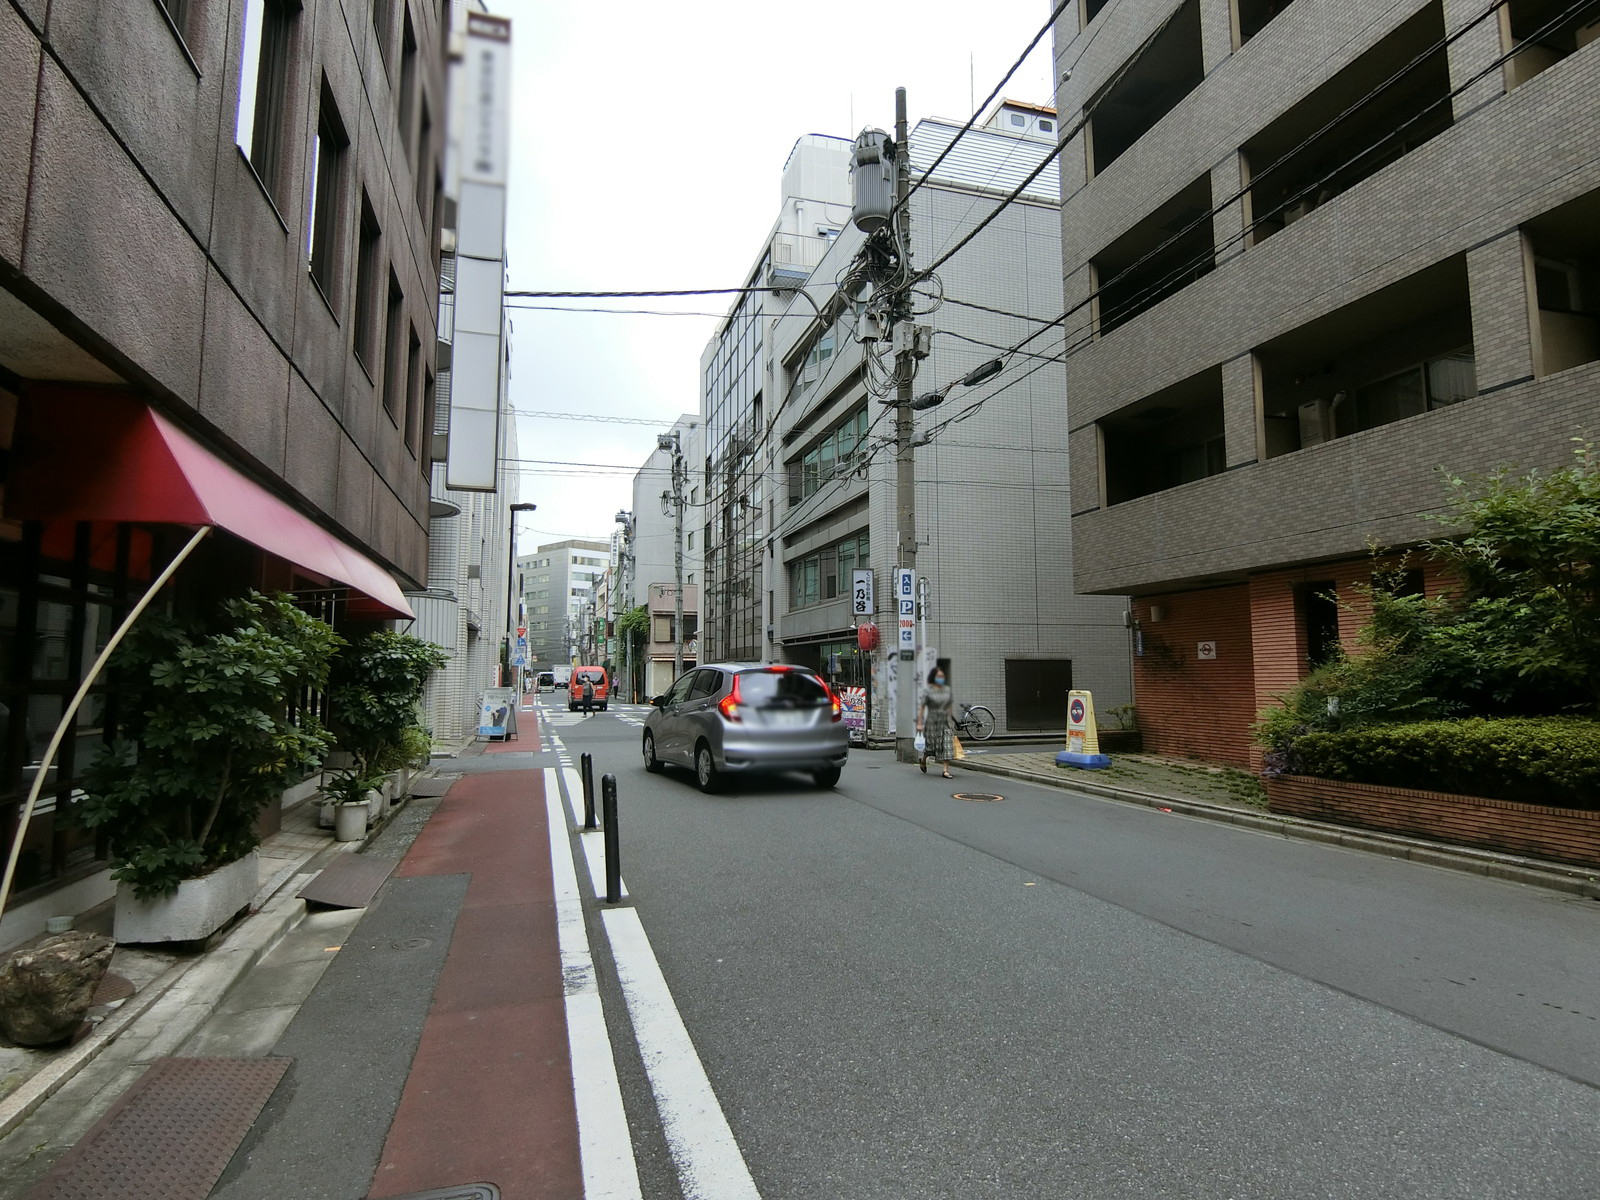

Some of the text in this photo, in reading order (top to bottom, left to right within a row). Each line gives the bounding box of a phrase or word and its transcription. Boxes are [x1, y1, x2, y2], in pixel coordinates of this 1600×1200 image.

[903, 576, 911, 593] 入口
[855, 579, 866, 612] 一乃谷
[901, 601, 913, 614] P
